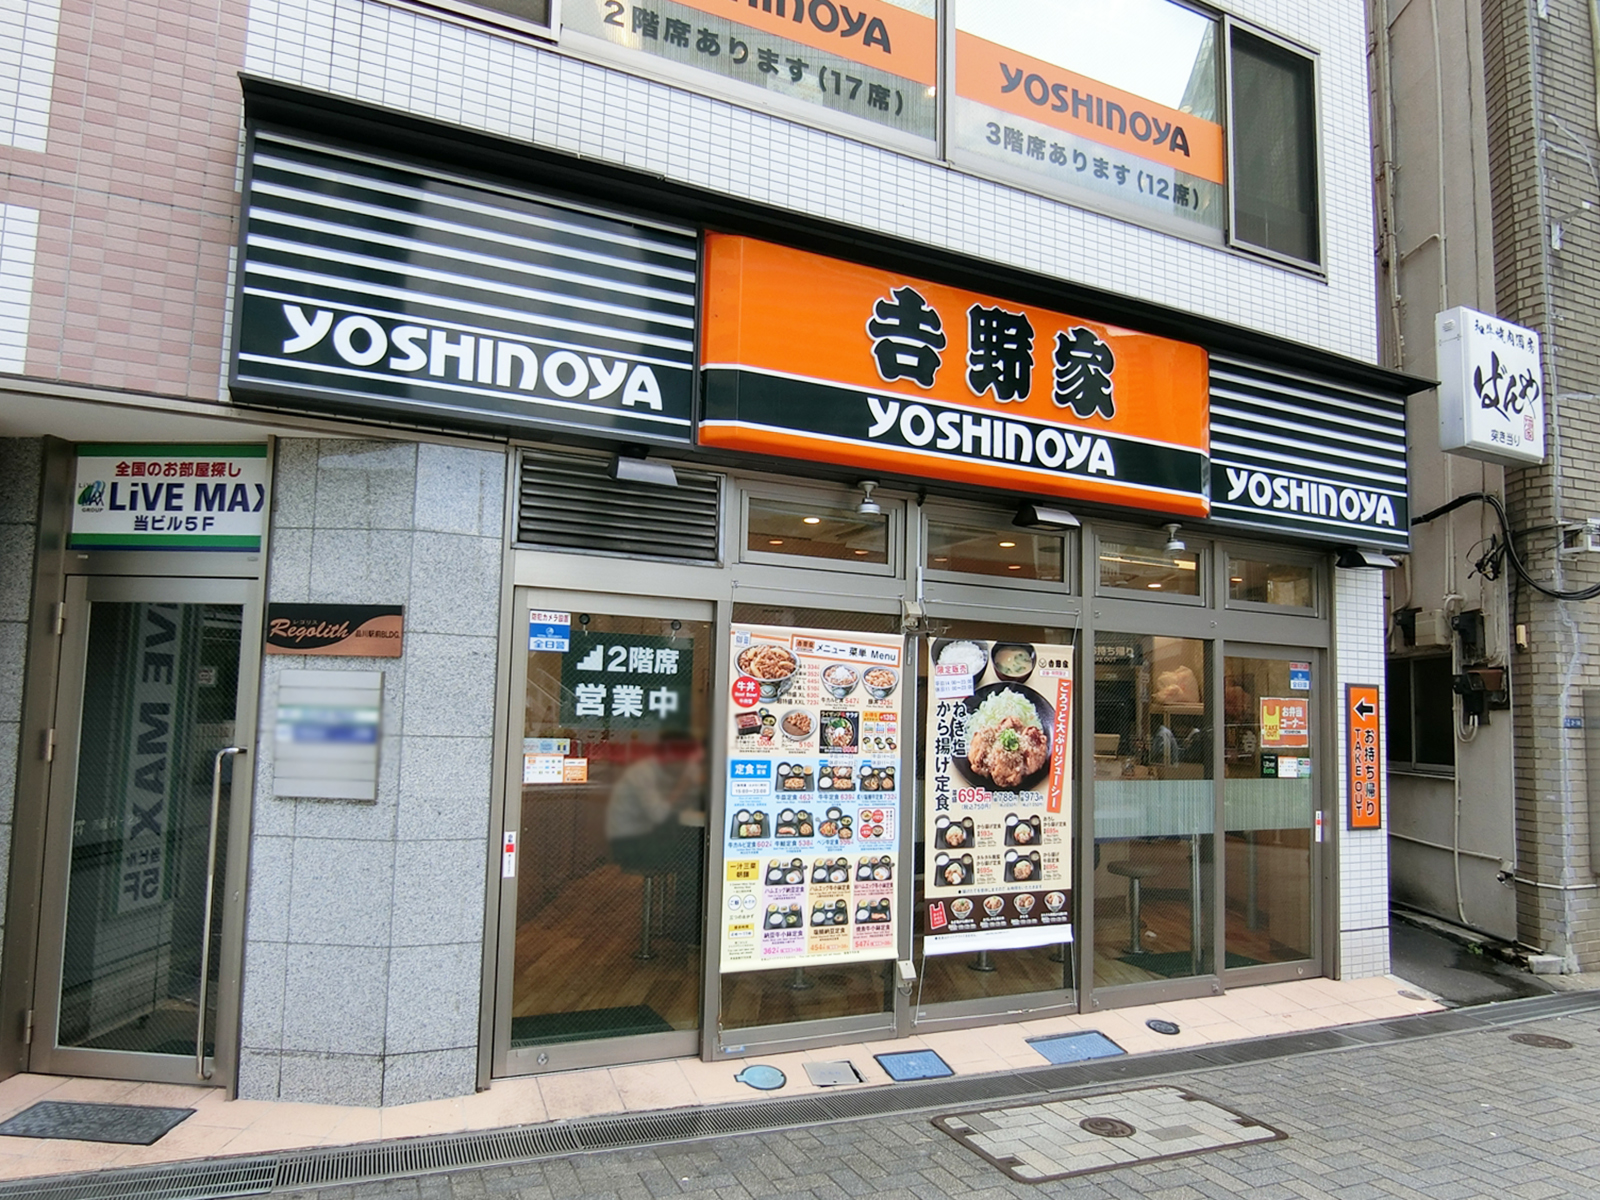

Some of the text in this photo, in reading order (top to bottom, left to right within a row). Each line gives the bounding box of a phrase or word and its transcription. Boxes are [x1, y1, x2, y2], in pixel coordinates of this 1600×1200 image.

[603, 0, 903, 117] 2階席あります(17席)
[999, 61, 1190, 158] YOSHINOYA
[985, 121, 1199, 211] 3階席あります(12席)
[282, 303, 663, 411] YOSHINOYA
[866, 285, 1116, 420] 吉野家
[867, 397, 1115, 477] YOSHINOYA
[115, 461, 241, 477] 全国のお部屋探し
[1225, 467, 1396, 527] YOSHINOYA
[134, 515, 215, 531] 当ビル5F
[269, 618, 350, 643] Regolith
[607, 646, 680, 675] 2階席
[816, 645, 846, 654] メニュー
[871, 650, 896, 660] Menu
[575, 683, 679, 719] 営業中
[737, 681, 755, 692] 牛丼
[1280, 718, 1305, 728] コーナー
[735, 763, 754, 775] 定食
[935, 701, 950, 811] から揚げ定食
[1354, 728, 1362, 816] TAKE OUT
[1364, 729, 1375, 816] お持ち帰り
